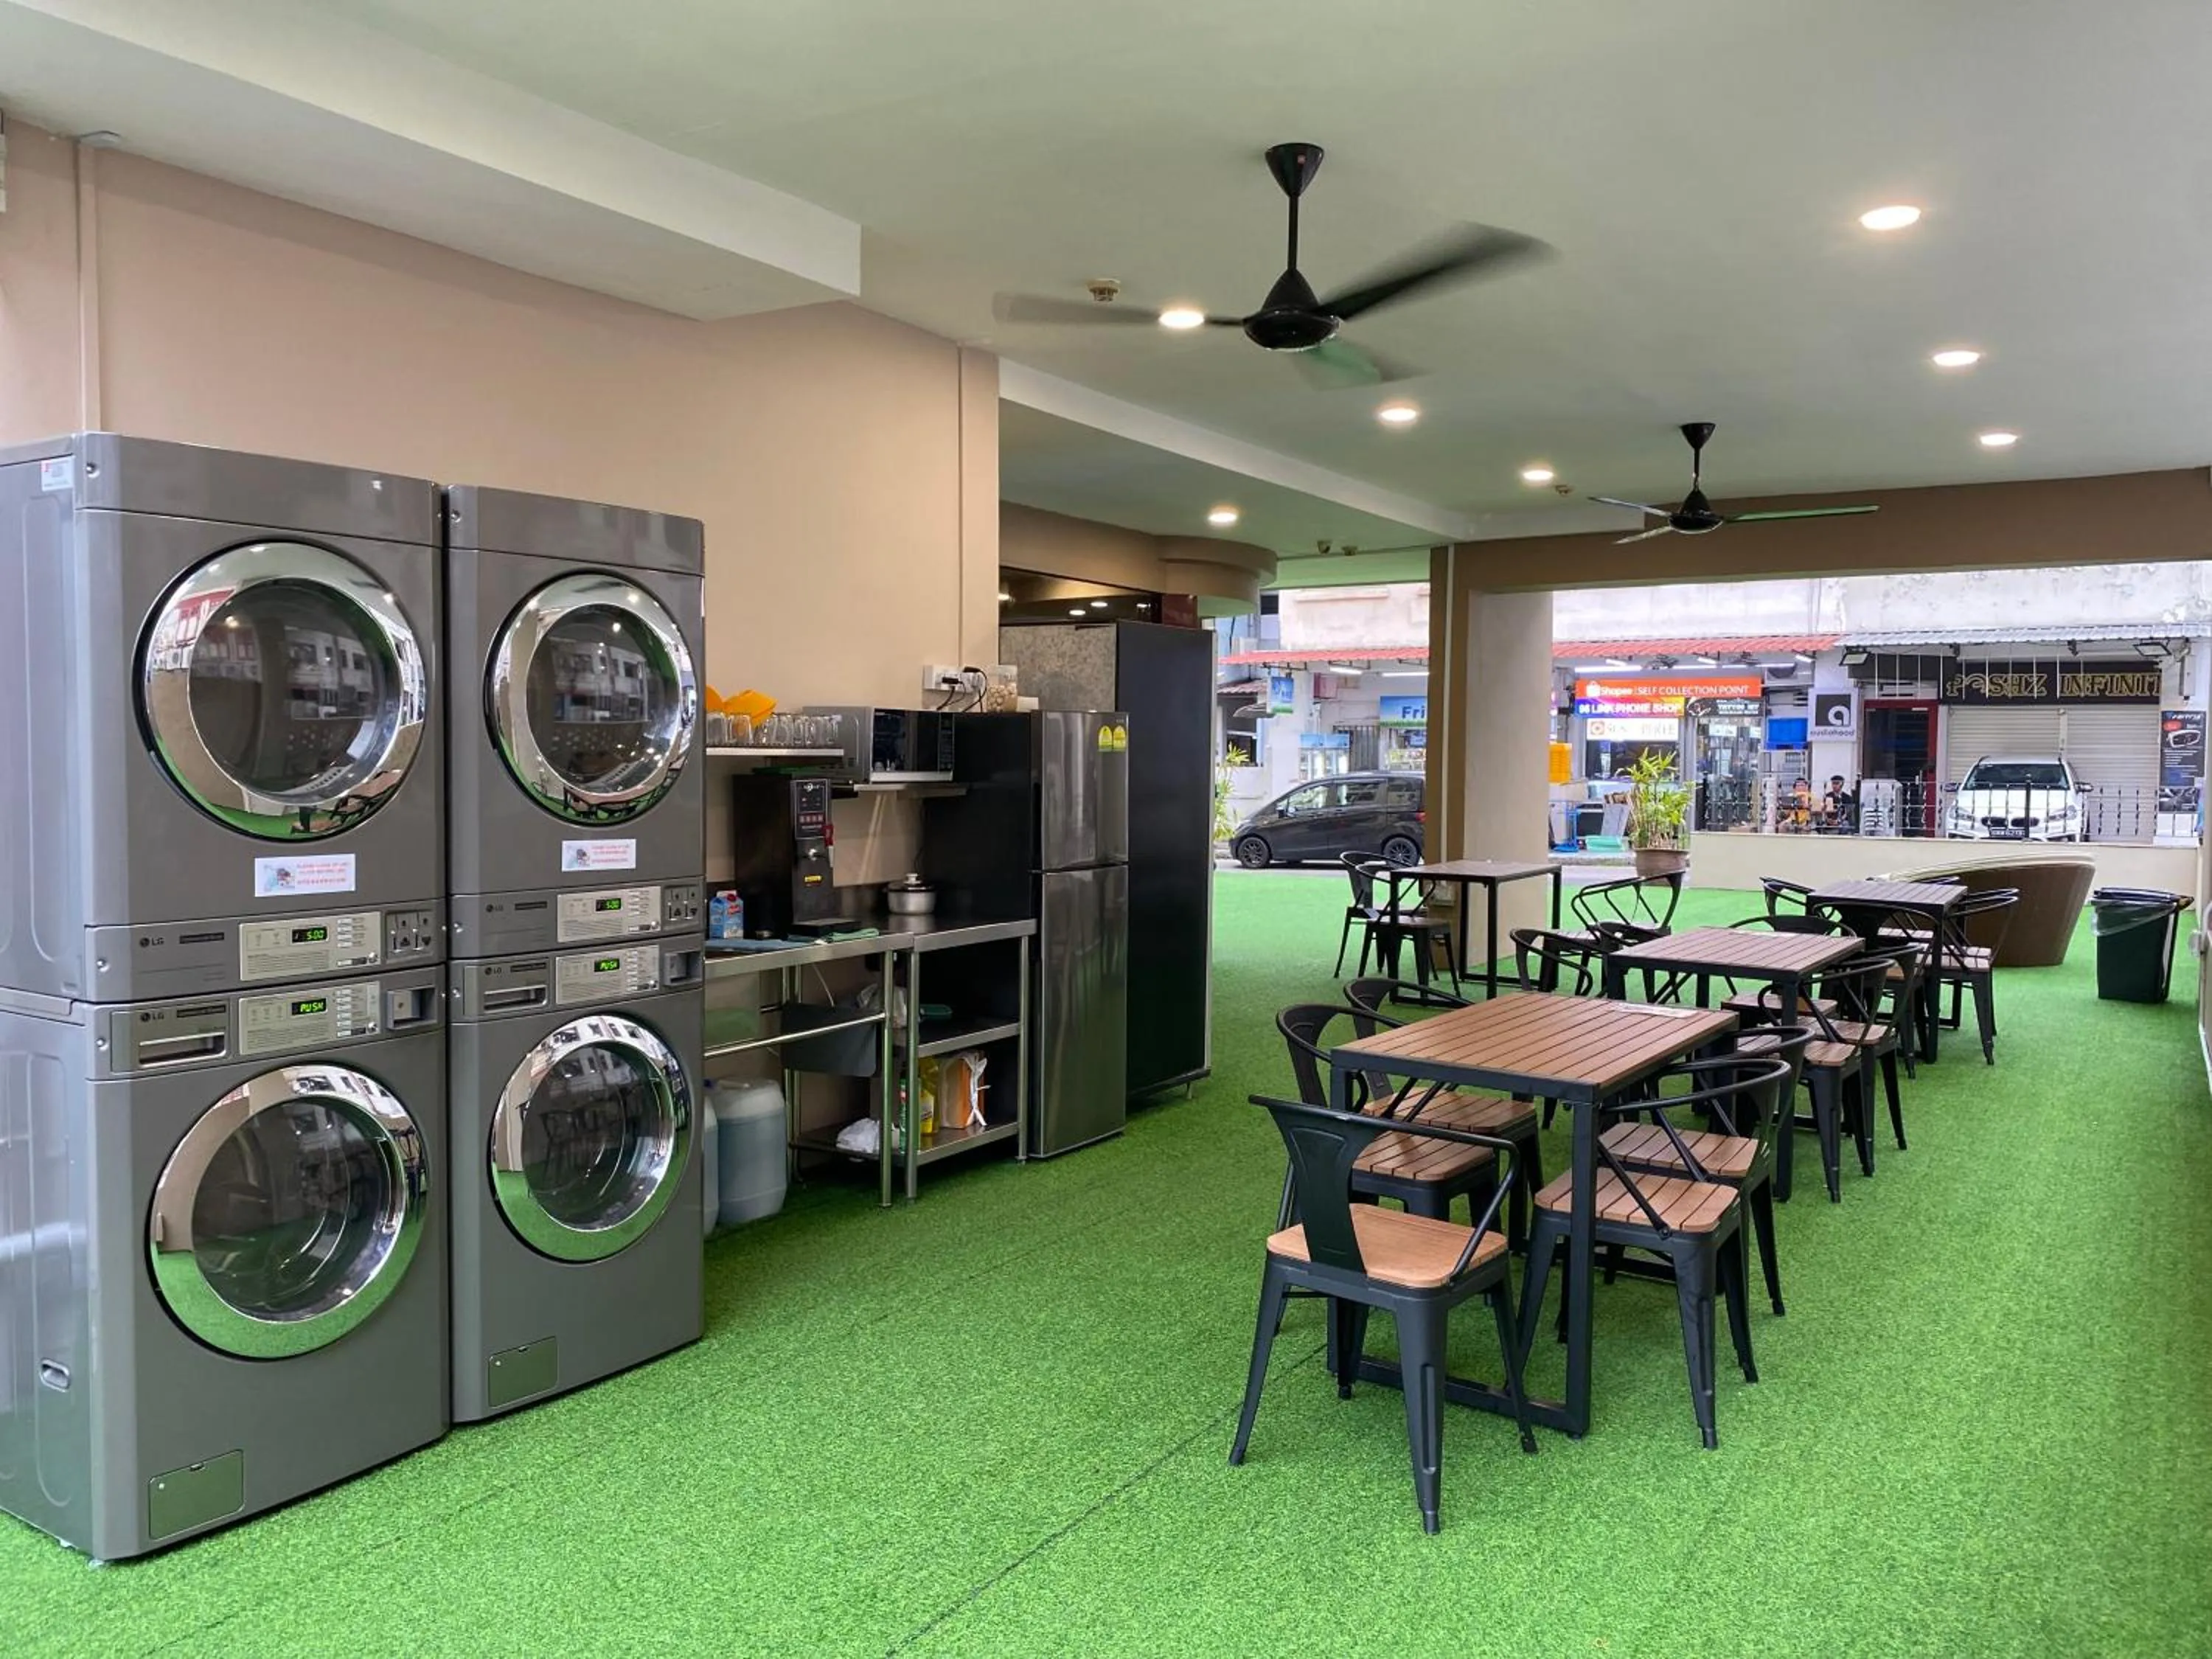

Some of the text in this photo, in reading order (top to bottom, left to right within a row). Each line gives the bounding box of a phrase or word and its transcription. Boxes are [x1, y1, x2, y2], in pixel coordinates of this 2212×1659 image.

[1638, 686, 1657, 695] SELF
[1659, 685, 1717, 695] COLLECTION
[1719, 684, 1750, 694] POINT
[1615, 703, 1652, 714] PHONE
[1652, 703, 1681, 714] SHOP
[300, 1001, 324, 1012] PUSH
